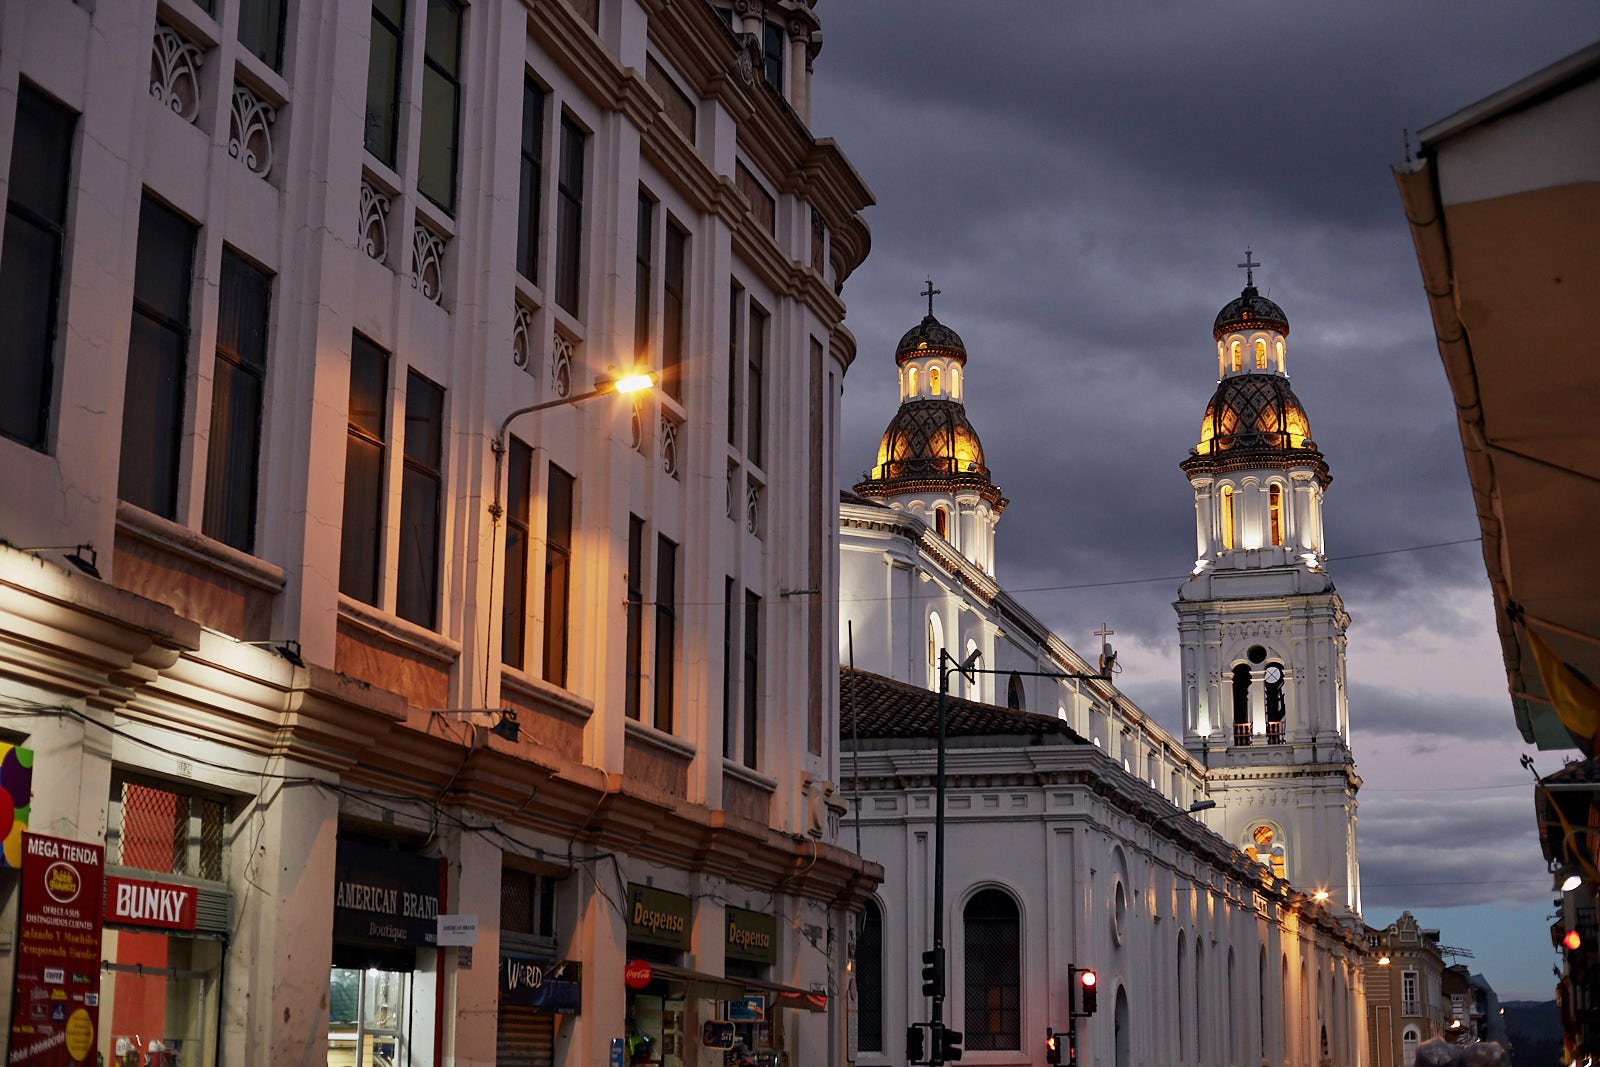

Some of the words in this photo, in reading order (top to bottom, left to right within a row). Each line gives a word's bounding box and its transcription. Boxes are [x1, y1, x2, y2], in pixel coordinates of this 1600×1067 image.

[27, 838, 59, 859] MEGA
[61, 844, 98, 866] TIENDA
[42, 905, 63, 917] OFRECE
[69, 909, 80, 919] SUS
[116, 883, 187, 923] BUNKY
[336, 881, 397, 915] AMERICAN
[402, 892, 438, 920] BRAND
[26, 914, 68, 927] DISTINGUIDOS
[68, 919, 93, 930] CLIENTES
[369, 920, 408, 942] Boutique
[633, 900, 684, 935] Despensa
[22, 928, 54, 941] alzado
[729, 922, 770, 950] Despensa
